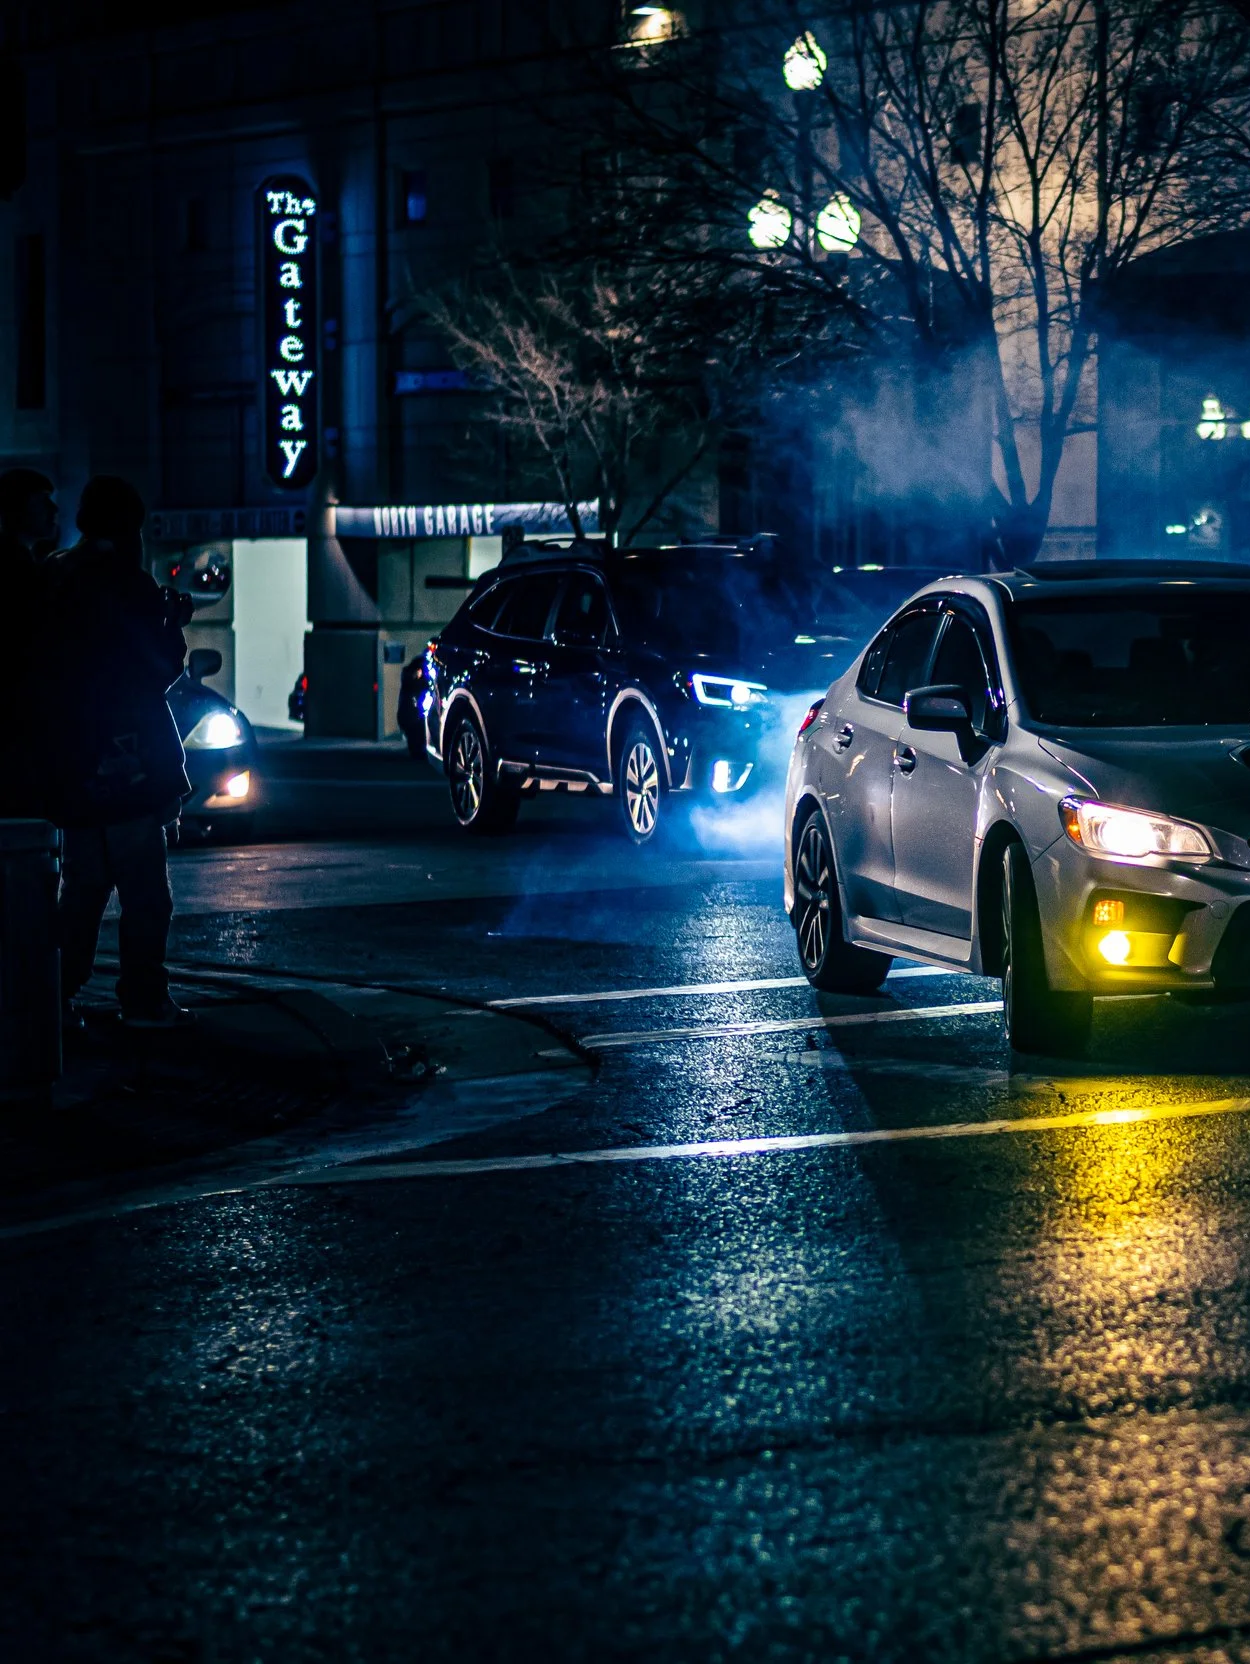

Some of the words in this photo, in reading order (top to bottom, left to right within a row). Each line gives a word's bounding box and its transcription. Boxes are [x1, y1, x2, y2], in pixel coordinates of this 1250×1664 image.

[267, 190, 316, 215] The
[270, 219, 313, 478] Gateway
[423, 503, 495, 535] GARAGE
